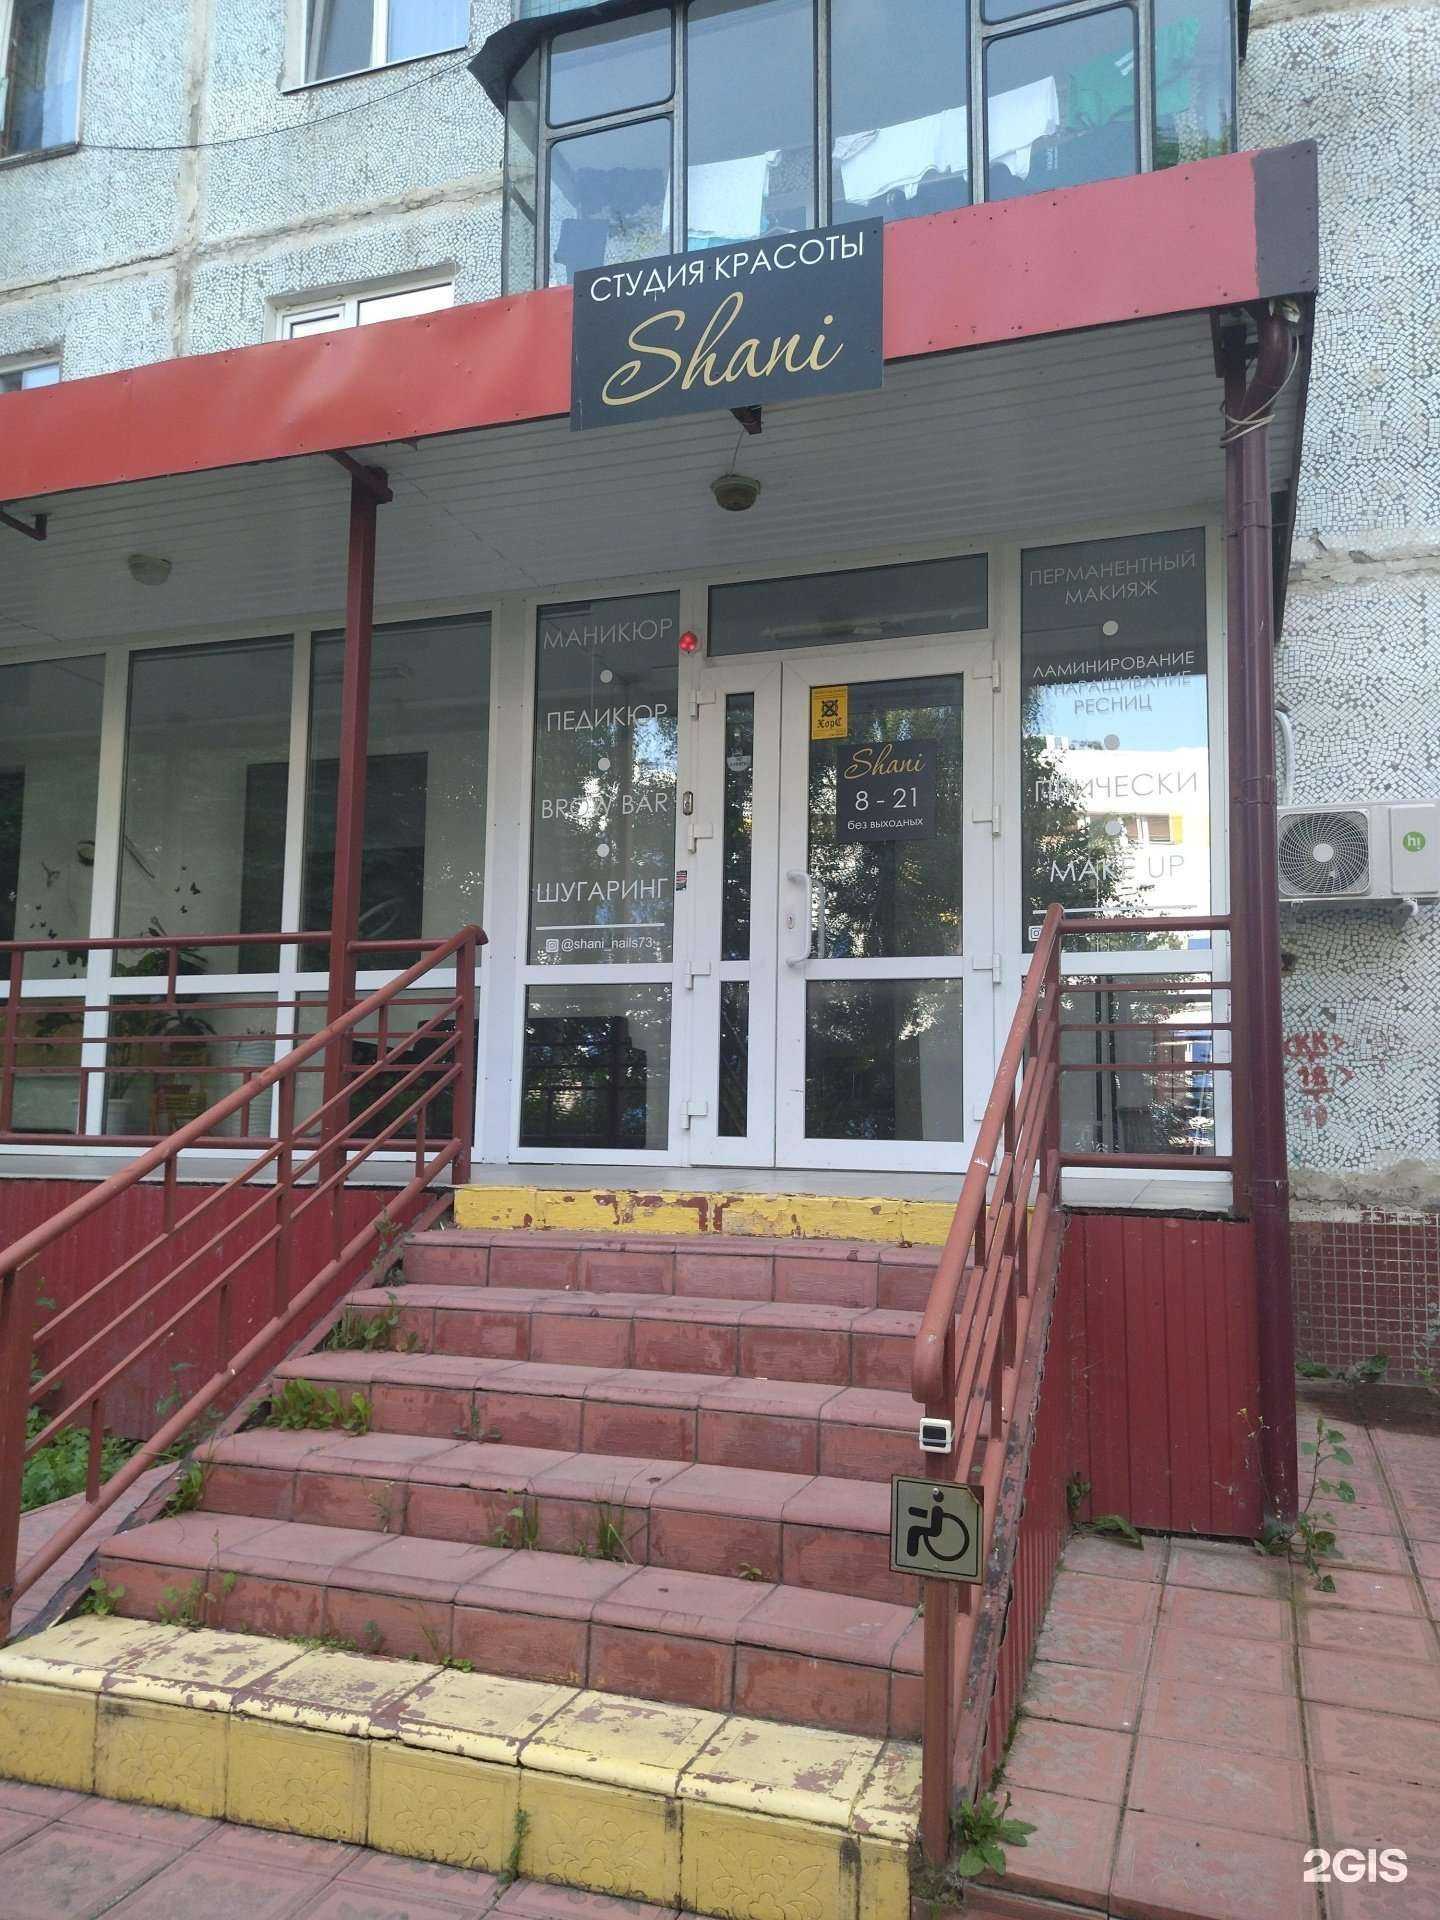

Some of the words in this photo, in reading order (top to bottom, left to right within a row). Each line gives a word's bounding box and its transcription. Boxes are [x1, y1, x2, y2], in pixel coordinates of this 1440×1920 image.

[590, 260, 704, 302] СТУДИЯ
[715, 232, 864, 281] КРАСОТЫ
[601, 291, 844, 406] Shani
[1029, 550, 1197, 586] ПЕРМАНЕНТНЫЙ
[1064, 580, 1158, 605] МАКИЯЖ
[543, 618, 673, 649] МАНИКЮР
[1033, 651, 1195, 678] ЛАМИНИРОВАНИЕ
[1074, 694, 1153, 714] РЕСНИЦ
[547, 704, 668, 732] ПЕДИКЮР
[844, 744, 926, 779] Shani
[541, 795, 613, 820] BROW
[622, 792, 668, 816] BAR
[855, 791, 869, 811] 8
[893, 787, 918, 809] 21
[847, 820, 868, 830] без
[870, 818, 924, 829] выходных
[1050, 857, 1136, 882] MAKE
[1147, 855, 1185, 878] UP
[537, 878, 669, 903] ШУГАРИНГ
